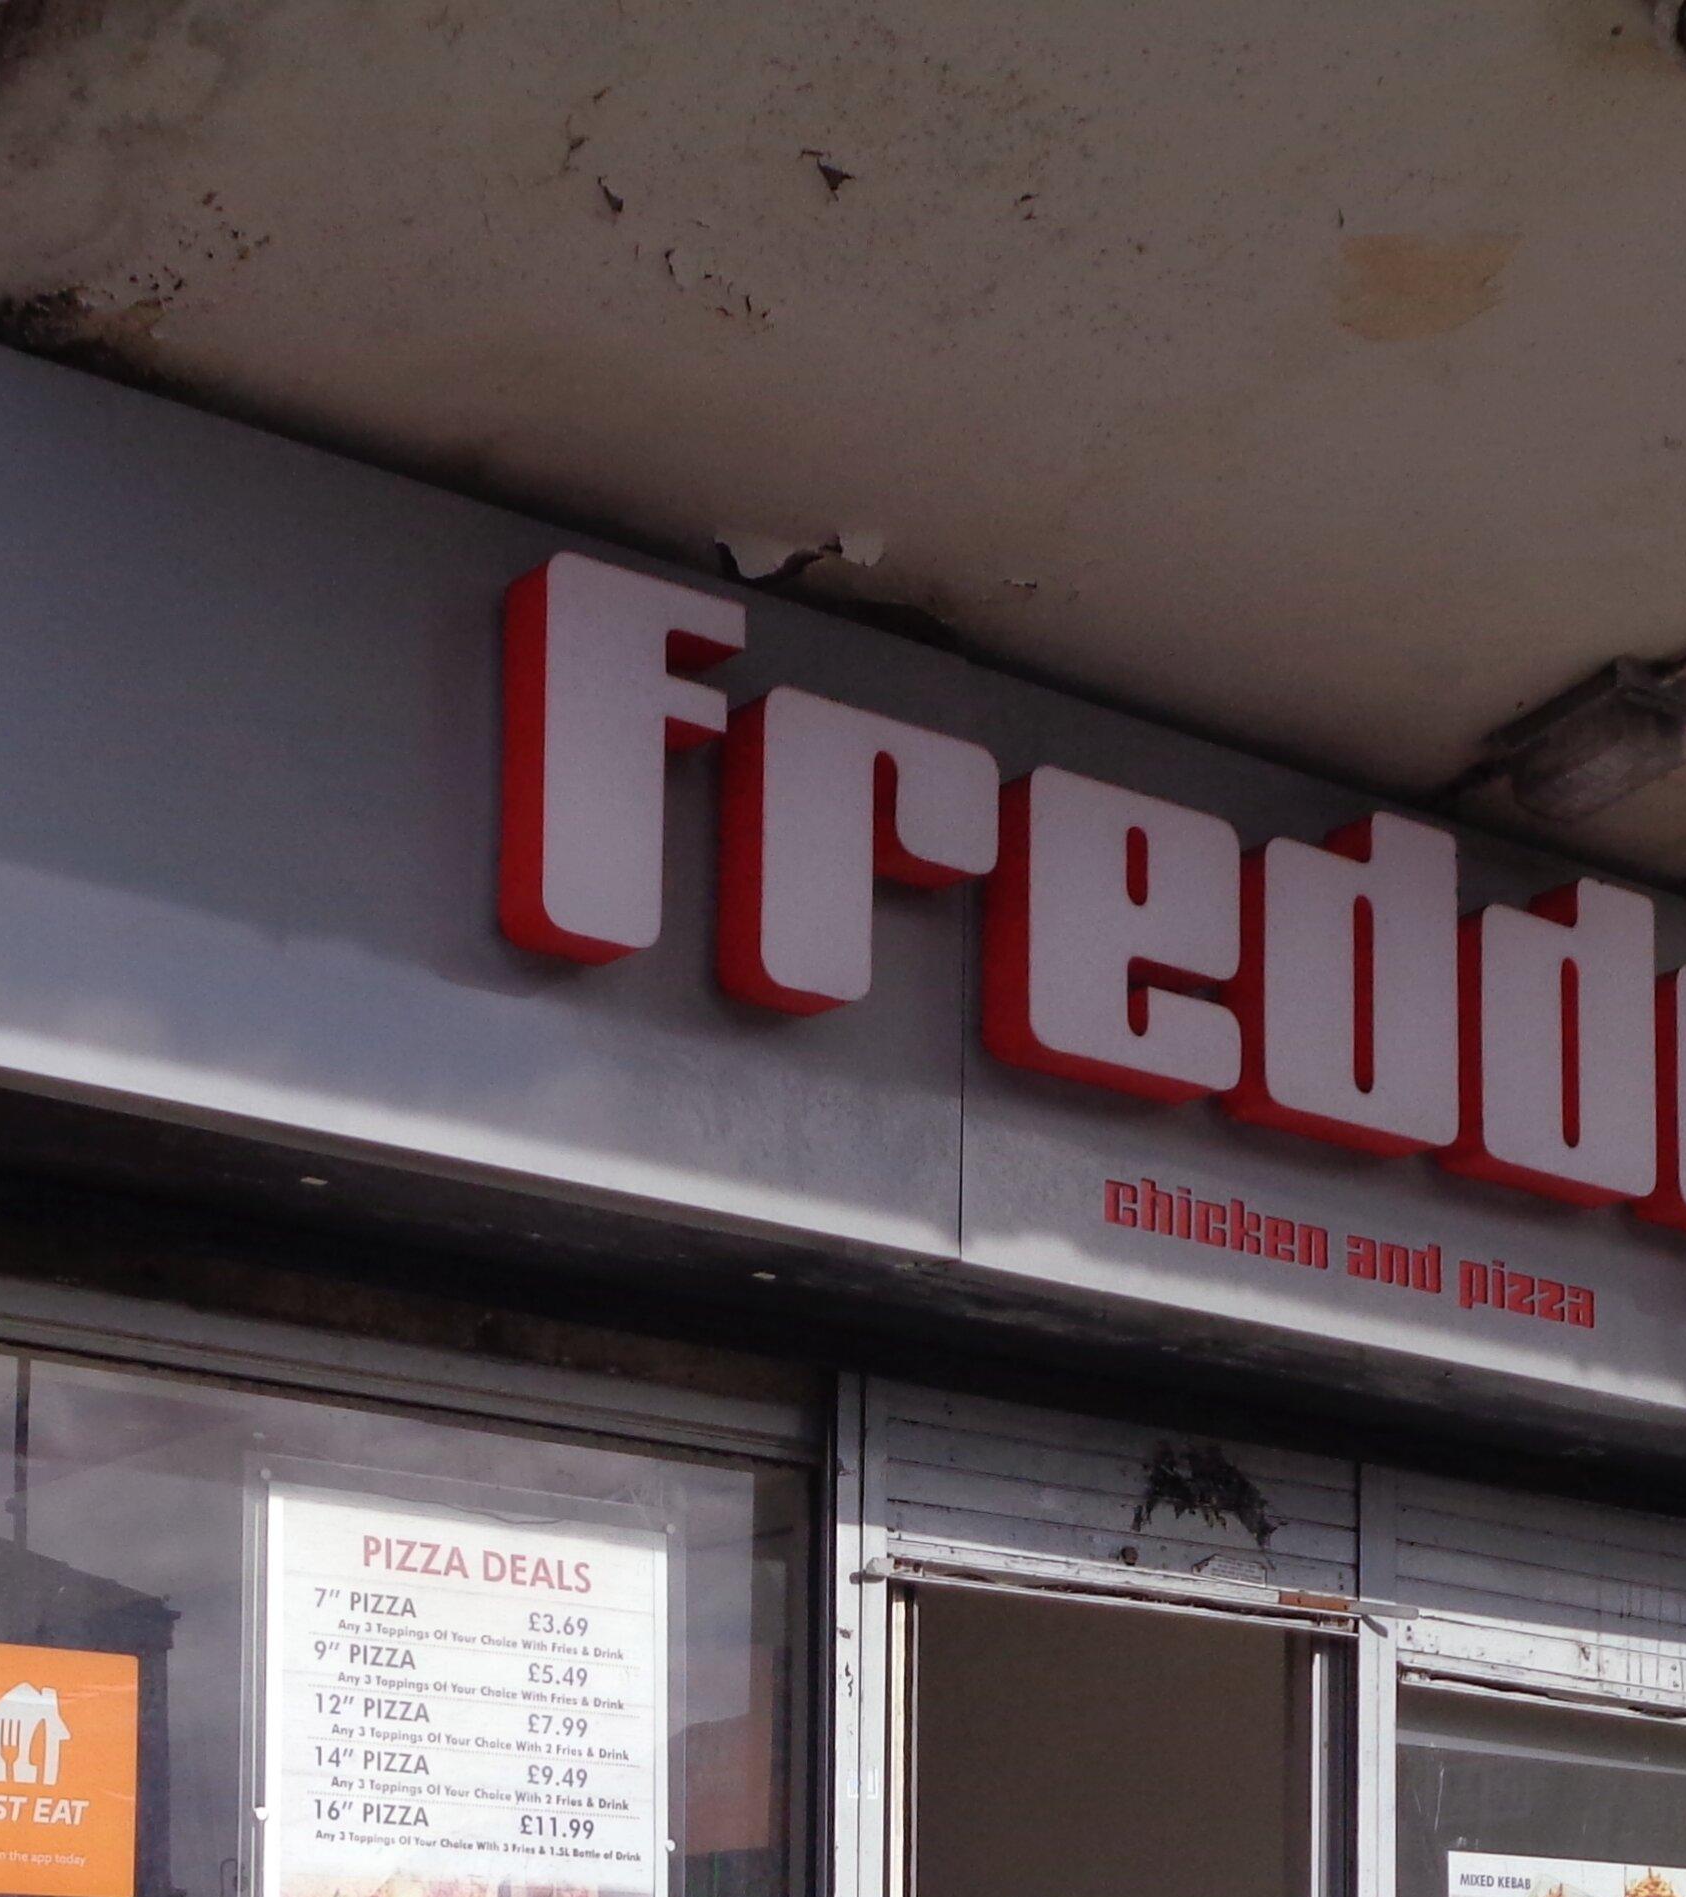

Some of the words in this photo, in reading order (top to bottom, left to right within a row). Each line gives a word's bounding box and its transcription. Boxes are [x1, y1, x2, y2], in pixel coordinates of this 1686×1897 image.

[1102, 1177, 1327, 1271] chicken
[1345, 1230, 1444, 1297] and
[1459, 1253, 1597, 1331] pizza
[363, 1535, 469, 1579] PIZZA
[482, 1550, 592, 1594] DEALS
[350, 1591, 417, 1618] PIZZA
[528, 1612, 589, 1637] £3.69
[338, 1619, 361, 1634] Any
[365, 1622, 372, 1632] 3
[376, 1623, 429, 1640] Toppings
[434, 1629, 447, 1640] Of
[451, 1631, 477, 1643] Your
[481, 1635, 517, 1648] Choice
[522, 1639, 547, 1652] With
[552, 1642, 578, 1655] Fries
[582, 1647, 589, 1656] &
[593, 1647, 624, 1660] Drink
[349, 1644, 416, 1670] PIZZA
[528, 1662, 588, 1687] £5.49
[364, 1697, 430, 1723] PIZZA
[528, 1713, 588, 1738] £7.99
[332, 1724, 354, 1738] Any
[358, 1726, 365, 1736] 3
[370, 1727, 423, 1744] Toppings
[427, 1733, 441, 1743] Of
[445, 1734, 471, 1746] Your
[475, 1737, 512, 1750] Choice
[516, 1740, 542, 1752] With
[546, 1744, 552, 1753] 2
[556, 1745, 583, 1756] Fries
[587, 1748, 594, 1757] &
[599, 1748, 629, 1761] Drink
[364, 1750, 430, 1775] PIZZA
[527, 1764, 588, 1788] £9.49
[33, 1798, 89, 1825] EAT
[331, 1776, 354, 1790] Any
[358, 1779, 365, 1789] 3
[369, 1780, 423, 1796] Toppings
[427, 1785, 441, 1795] Of
[445, 1786, 470, 1798] Your
[474, 1788, 512, 1801] Choice
[515, 1790, 542, 1804] With
[546, 1795, 552, 1804] 2
[556, 1795, 583, 1807] Fries
[587, 1798, 594, 1808] &
[599, 1798, 629, 1811] Drink
[363, 1803, 429, 1827] PIZZA
[520, 1814, 594, 1839] £11.99
[9, 1849, 29, 1862] the
[31, 1852, 52, 1866] app
[55, 1851, 87, 1867] today
[315, 1830, 335, 1842] Any
[339, 1831, 346, 1841] 3
[349, 1832, 396, 1846] Toppings
[399, 1835, 411, 1845] Of
[415, 1836, 436, 1847] Your
[440, 1838, 473, 1850] Choice
[476, 1841, 500, 1851] With
[512, 1844, 535, 1854] Fries
[539, 1846, 546, 1855] &
[573, 1848, 600, 1859] Bottle
[603, 1851, 613, 1860] of
[616, 1851, 641, 1862] Drink
[1460, 1873, 1495, 1887] MIXED
[1497, 1876, 1531, 1890] KEBAB
